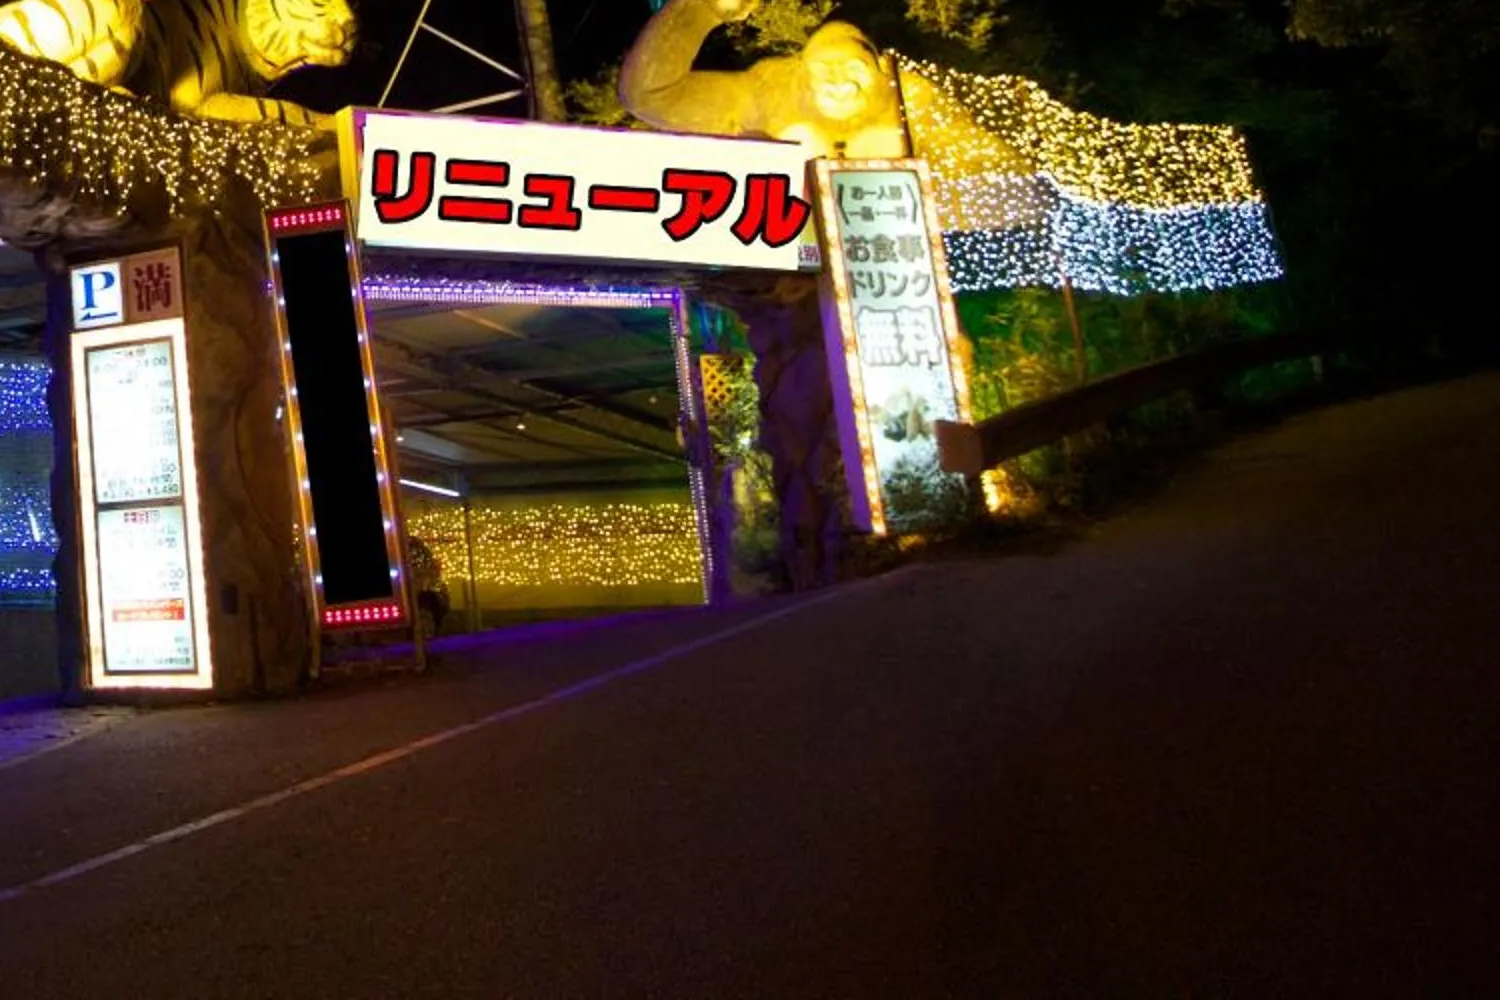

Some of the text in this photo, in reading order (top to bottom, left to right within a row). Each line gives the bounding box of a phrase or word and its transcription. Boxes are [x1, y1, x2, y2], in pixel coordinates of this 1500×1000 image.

[844, 233, 925, 264] お食事
[79, 270, 115, 310] P
[132, 262, 172, 312] 満
[848, 270, 931, 299] ドリンク
[857, 305, 943, 367] 無料
